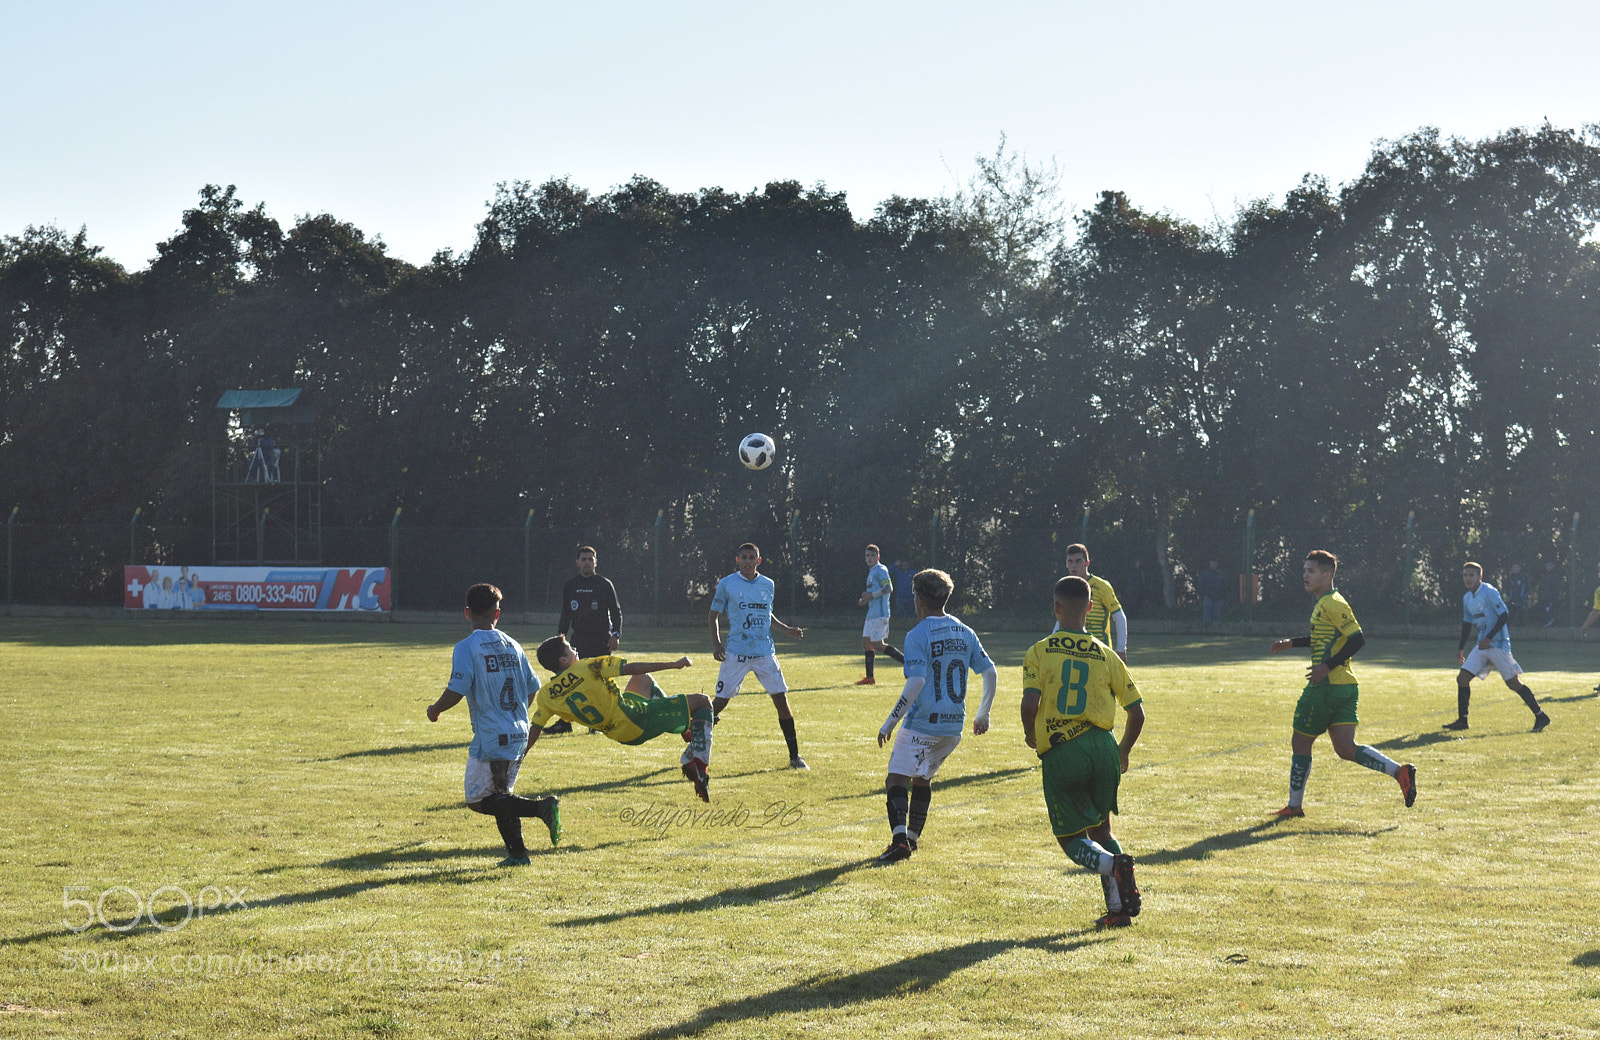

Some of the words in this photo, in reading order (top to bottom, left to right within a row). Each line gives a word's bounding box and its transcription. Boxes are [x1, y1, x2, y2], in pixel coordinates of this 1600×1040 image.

[235, 584, 317, 603] 0800-333-4670
[1048, 636, 1102, 656] ROCA
[500, 677, 519, 720] 4
[716, 680, 724, 694] 9
[932, 659, 967, 704] 10
[1056, 658, 1090, 716] 8
[565, 691, 605, 726] 6
